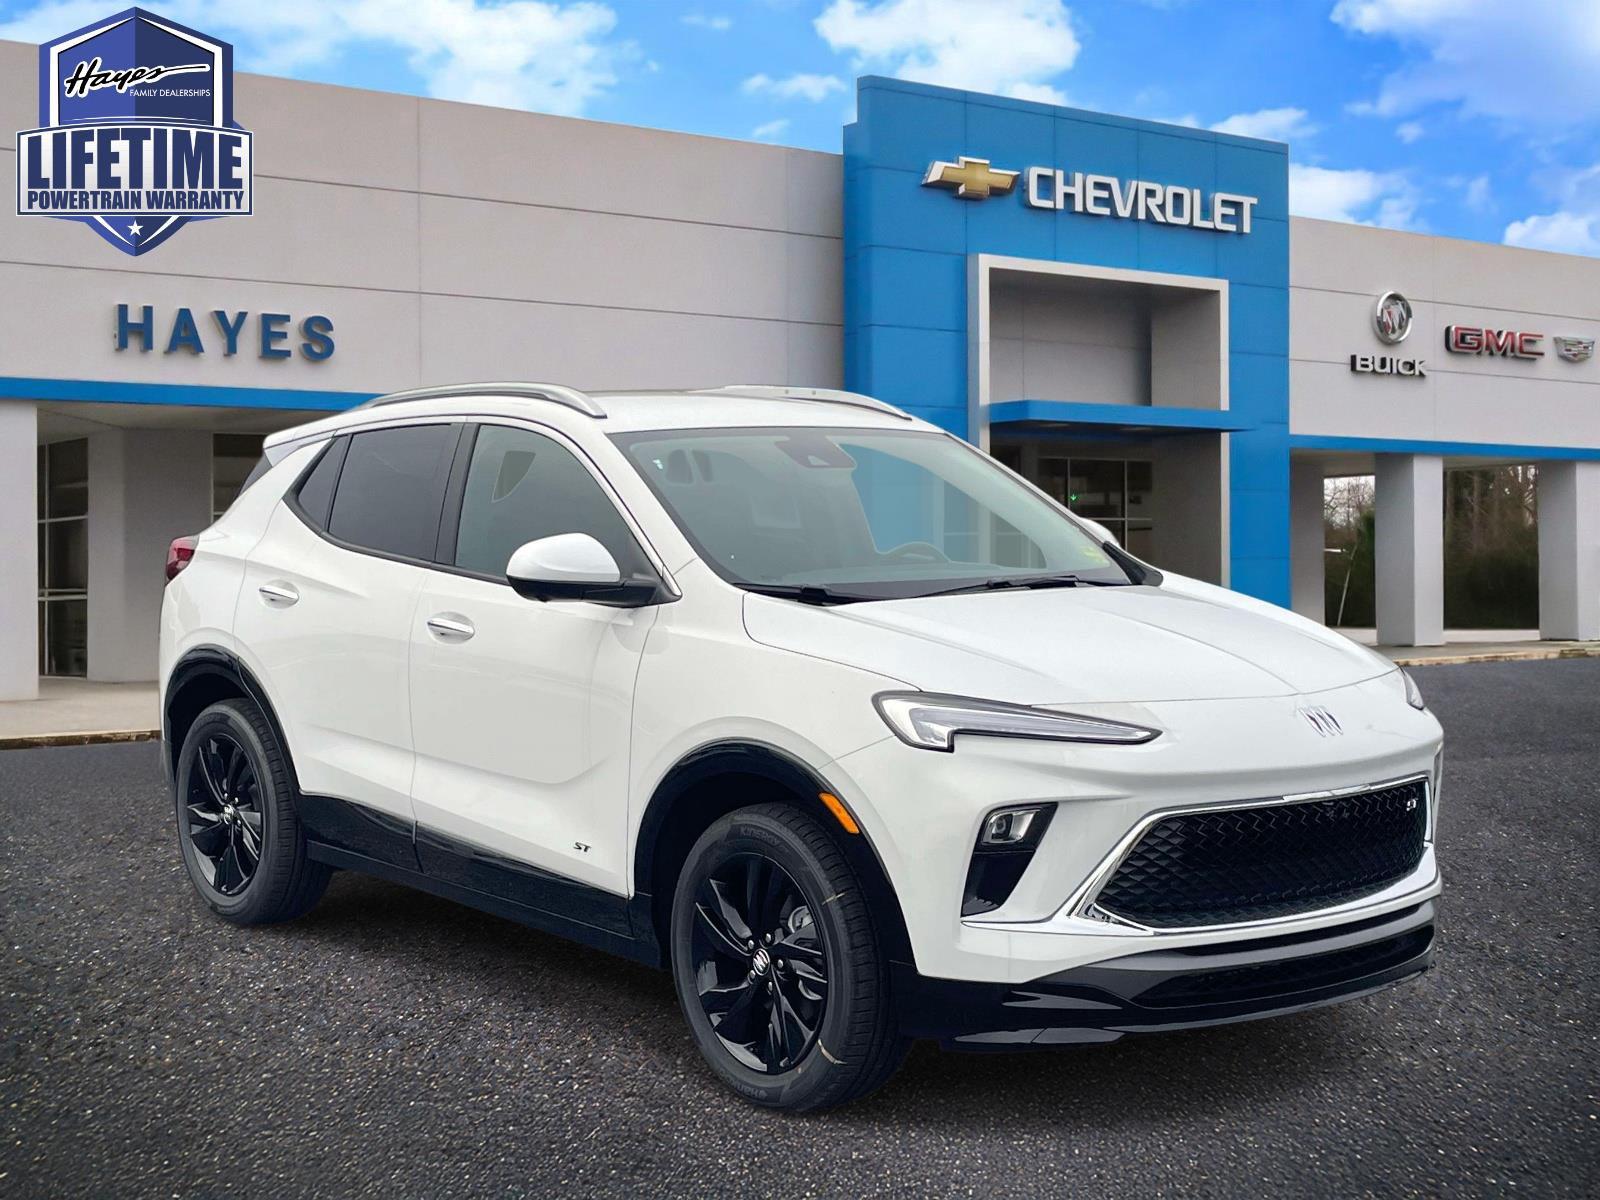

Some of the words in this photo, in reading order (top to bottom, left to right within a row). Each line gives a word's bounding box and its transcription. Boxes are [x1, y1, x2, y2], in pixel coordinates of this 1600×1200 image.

[1026, 166, 1258, 233] CHEVROLET
[113, 303, 336, 361] HAYES
[1445, 325, 1546, 361] GMC
[1350, 354, 1427, 377] BUICK
[573, 841, 592, 853] ST
